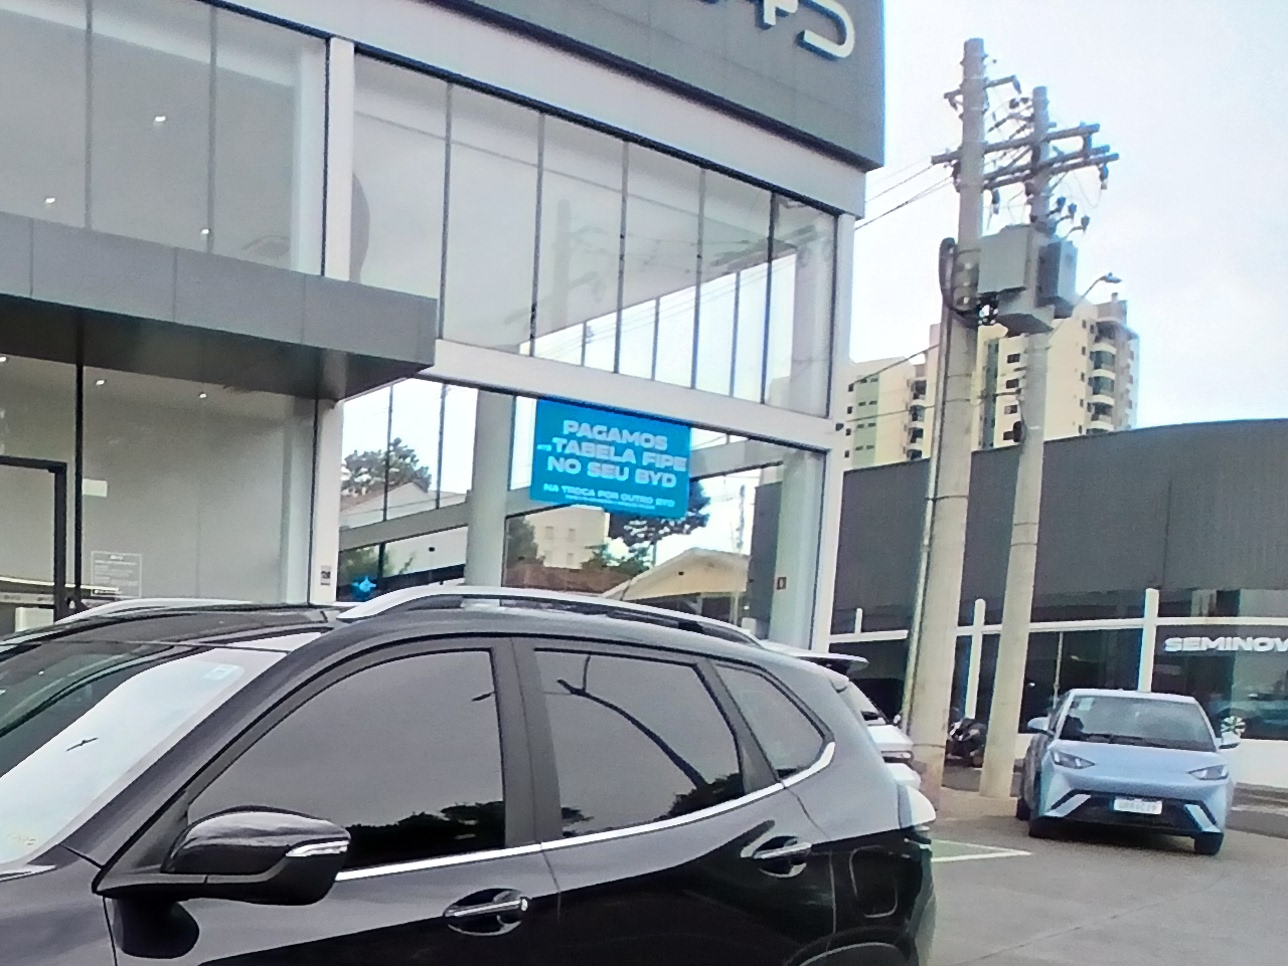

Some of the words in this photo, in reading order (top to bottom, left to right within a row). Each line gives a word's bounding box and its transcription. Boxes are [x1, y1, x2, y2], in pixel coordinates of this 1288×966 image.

[562, 419, 668, 451] PAGAMOS
[552, 437, 637, 464] TABELA
[641, 450, 688, 472] FIPE
[547, 455, 582, 475] NO
[586, 461, 630, 482] SEU
[634, 468, 677, 489] BYD
[561, 485, 596, 497] TROCA
